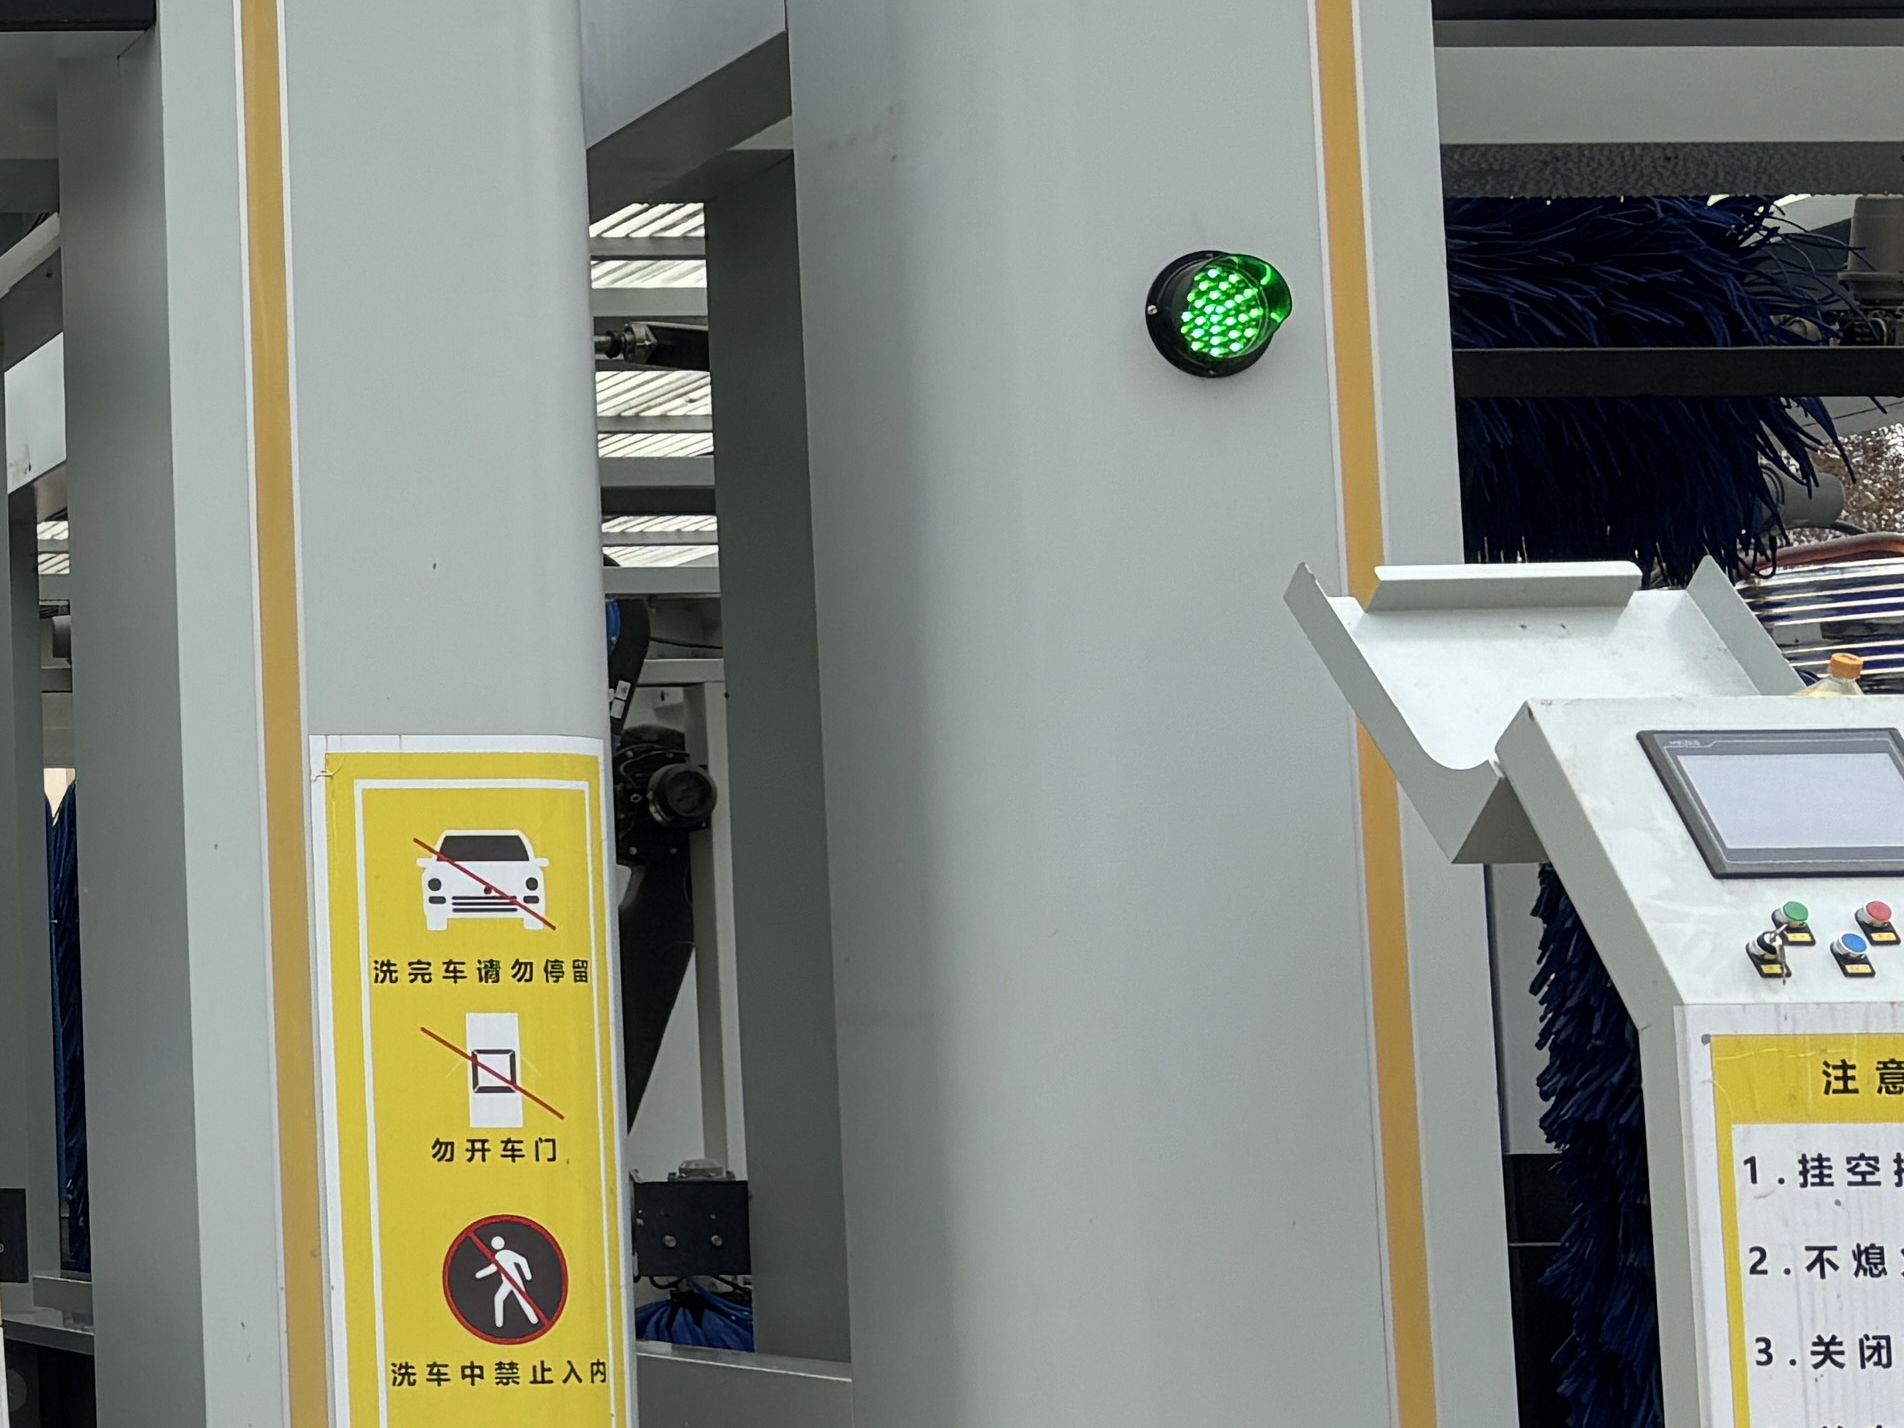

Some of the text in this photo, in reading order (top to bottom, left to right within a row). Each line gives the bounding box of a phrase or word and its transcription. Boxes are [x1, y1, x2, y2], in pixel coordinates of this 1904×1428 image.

[373, 958, 589, 985] 洗完车请勿停留
[431, 1137, 557, 1164] 勿开车门
[1749, 1243, 1904, 1280] 2.不熄
[391, 1358, 607, 1387] 洗车中禁止入内
